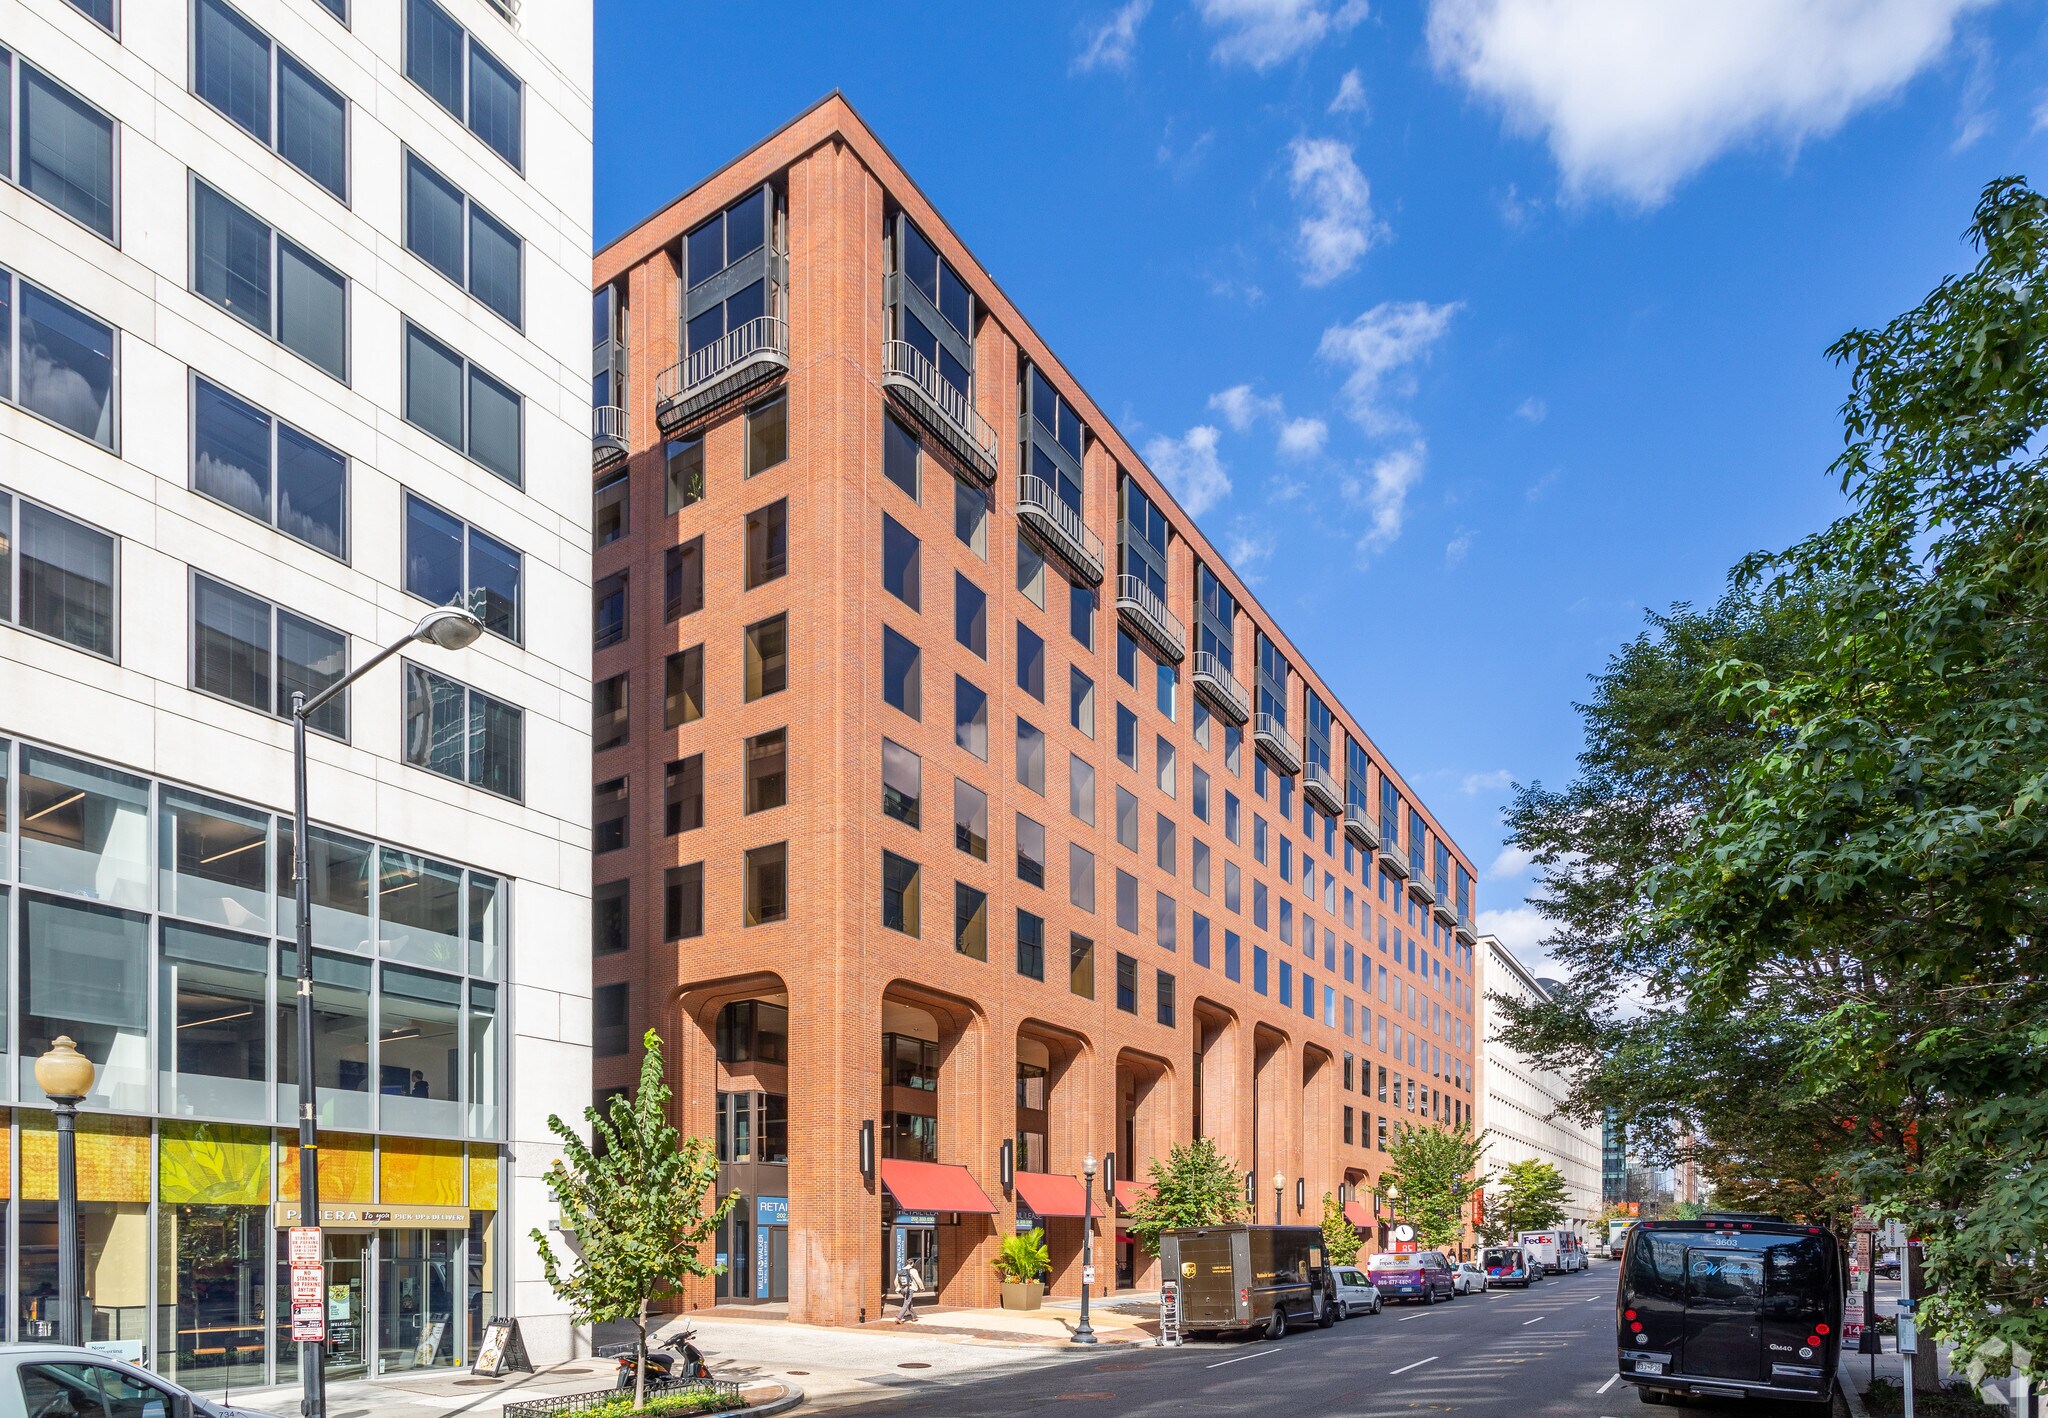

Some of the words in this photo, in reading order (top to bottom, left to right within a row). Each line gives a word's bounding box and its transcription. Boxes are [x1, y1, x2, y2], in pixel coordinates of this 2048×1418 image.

[287, 1209, 358, 1221] PERA
[364, 1212, 373, 1220] to
[375, 1213, 390, 1225] you
[1523, 1235, 1553, 1245] FedEx
[1716, 1239, 1738, 1247] 3603
[1769, 1343, 1793, 1352] GM40
